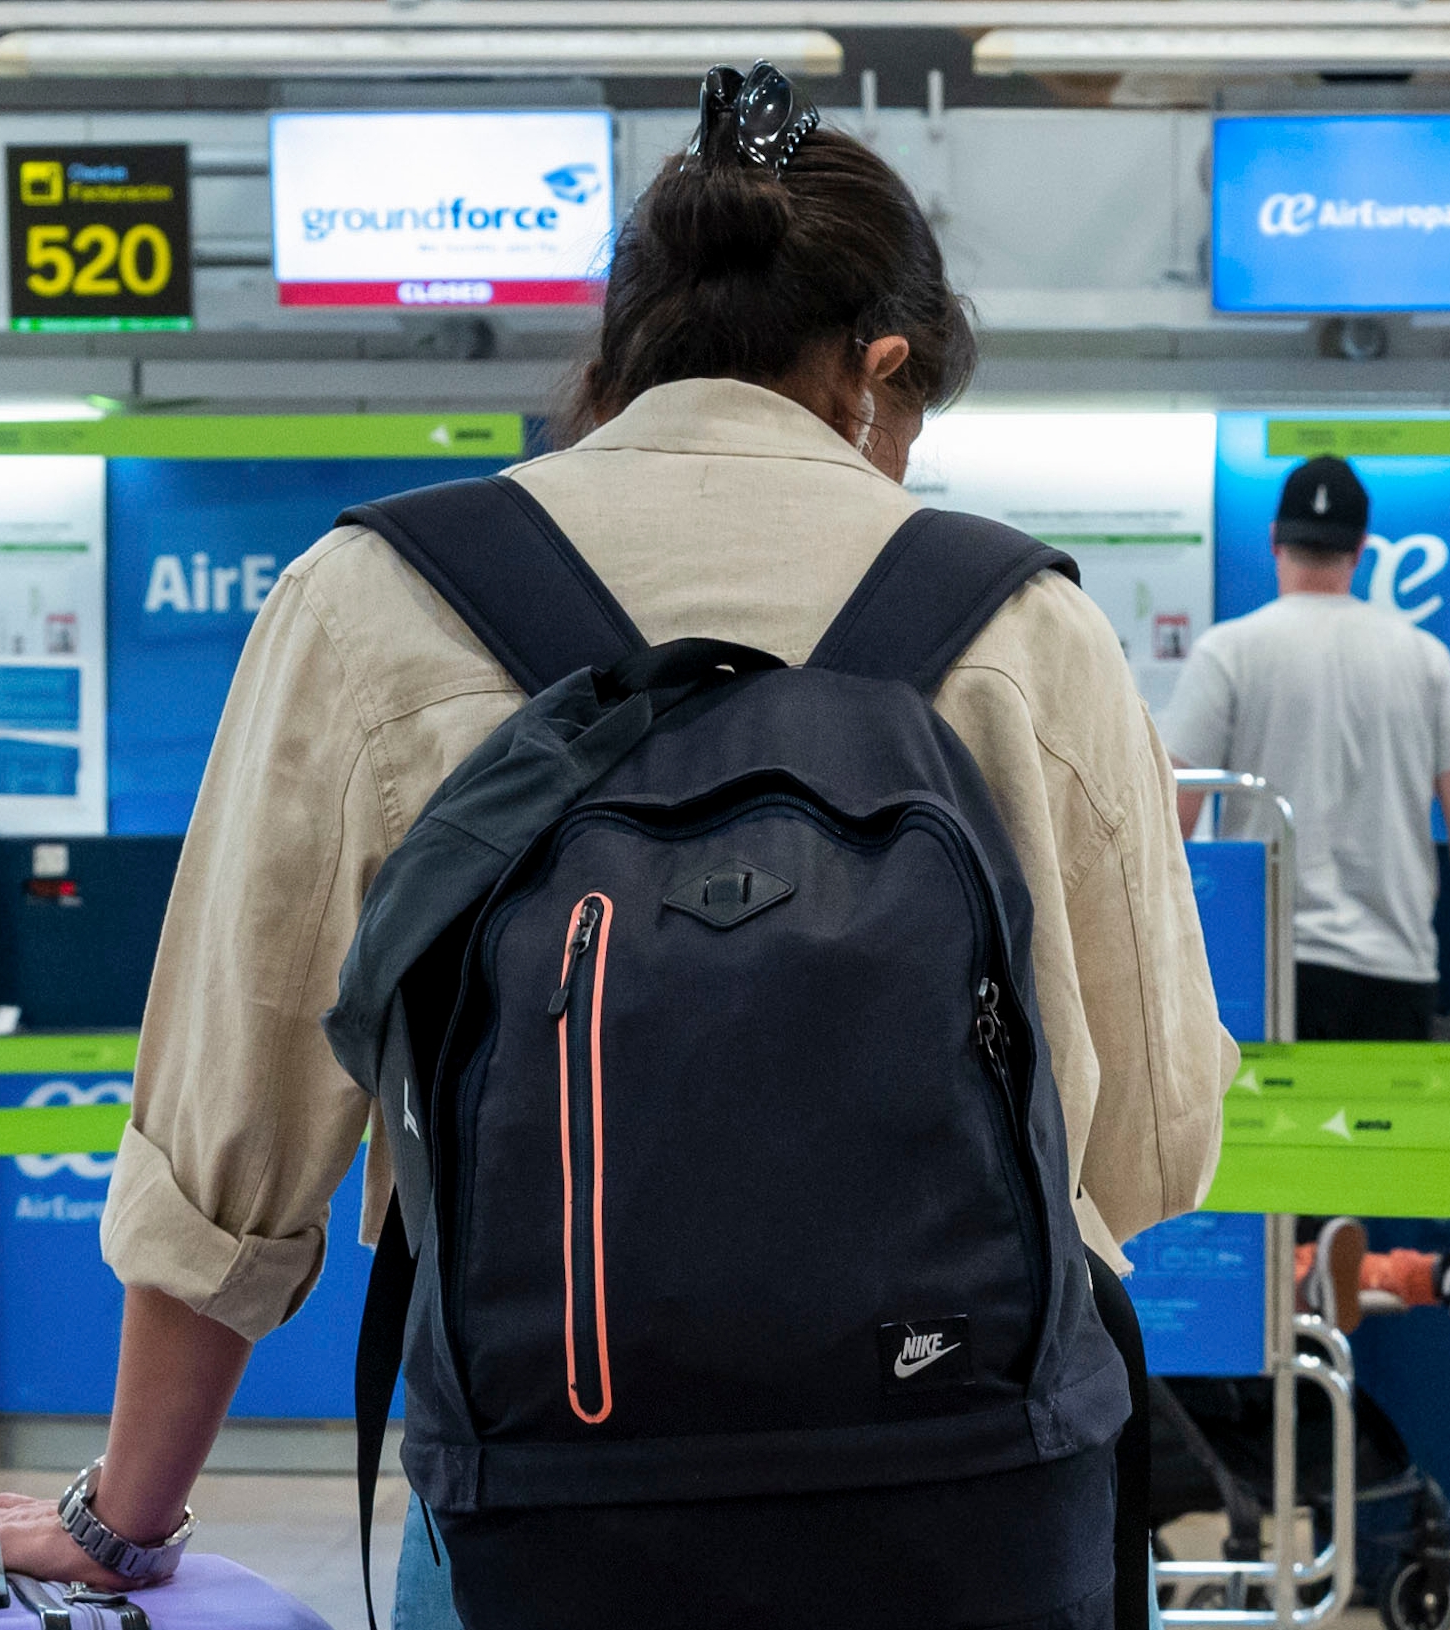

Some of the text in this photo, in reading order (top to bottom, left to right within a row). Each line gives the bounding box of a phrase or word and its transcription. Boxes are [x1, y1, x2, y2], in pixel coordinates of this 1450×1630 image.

[302, 198, 558, 242] groundforce
[26, 224, 172, 297] 520
[144, 552, 278, 614] AirE
[901, 1332, 943, 1361] NIKE
